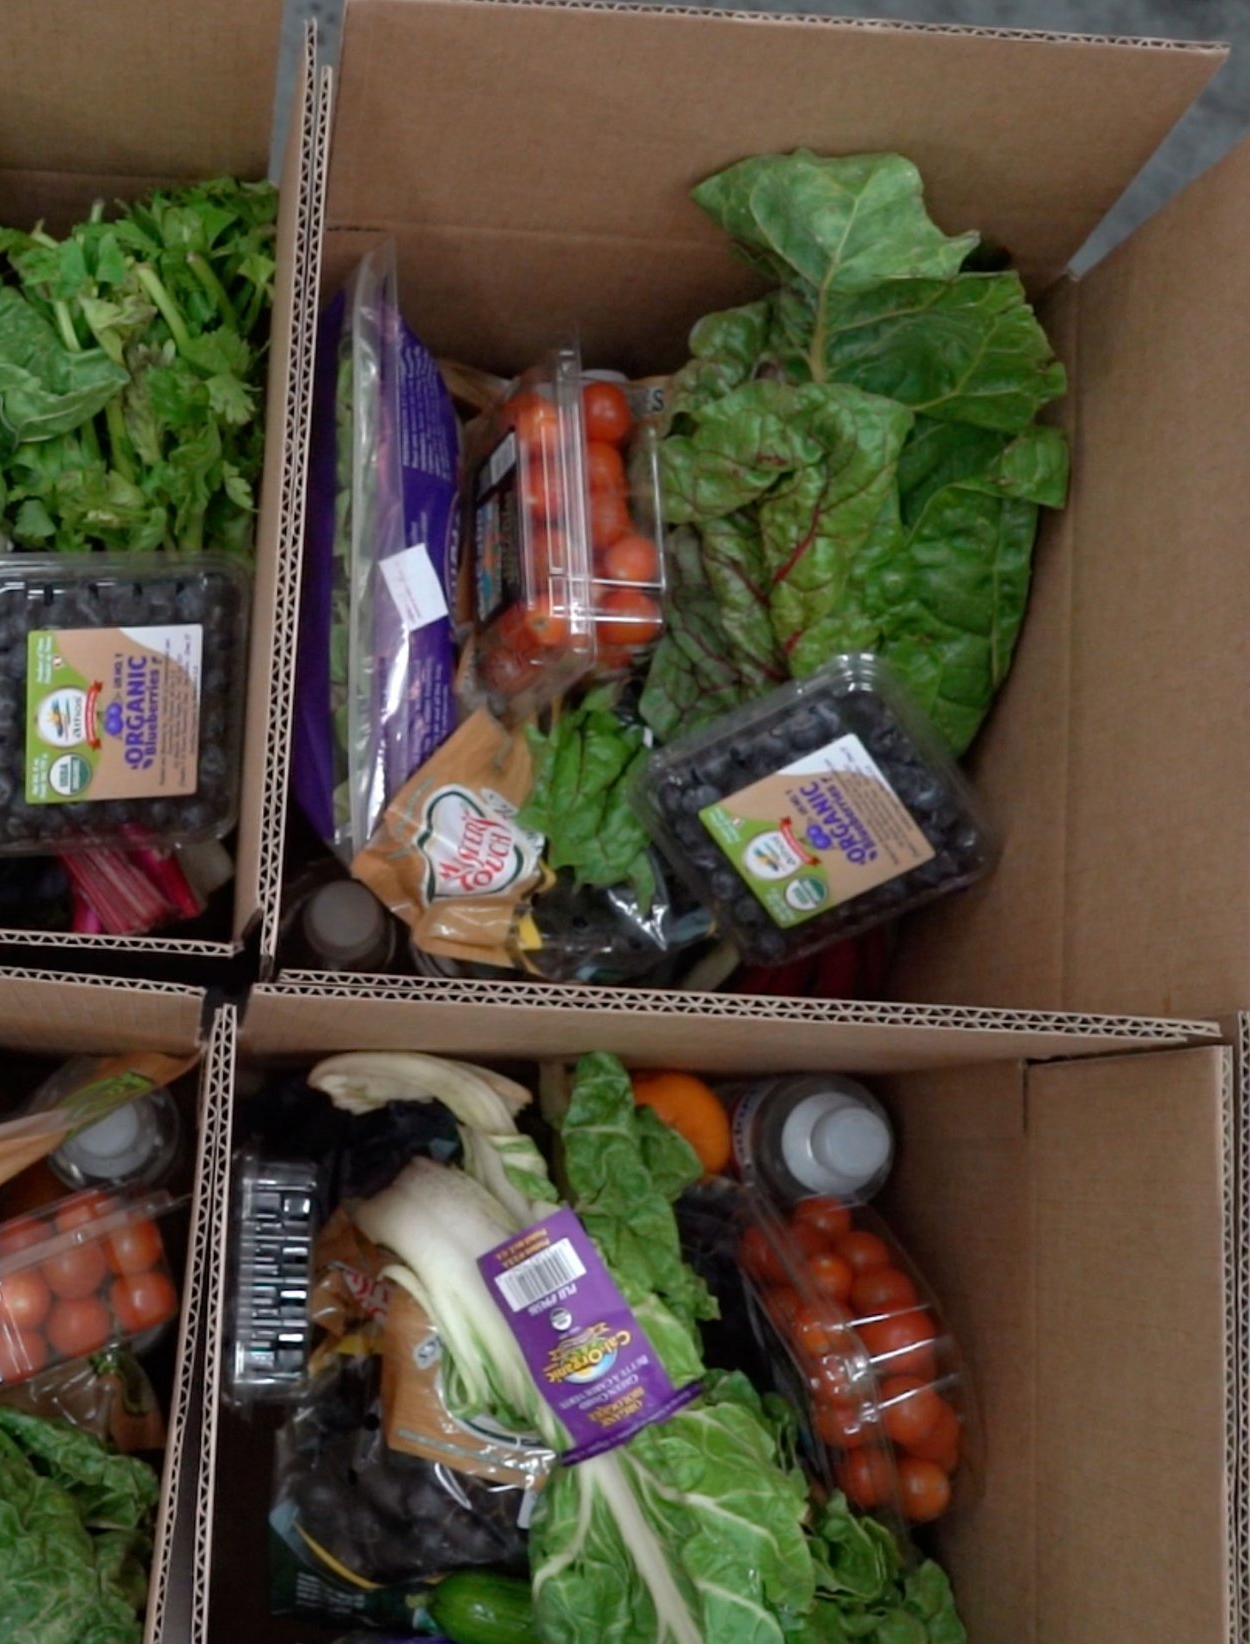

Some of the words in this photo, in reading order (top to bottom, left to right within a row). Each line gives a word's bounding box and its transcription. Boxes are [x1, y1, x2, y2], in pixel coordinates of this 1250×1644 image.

[124, 655, 147, 766] ORGANIC
[143, 669, 160, 757] Blueberries
[800, 781, 866, 863] ORGANIC
